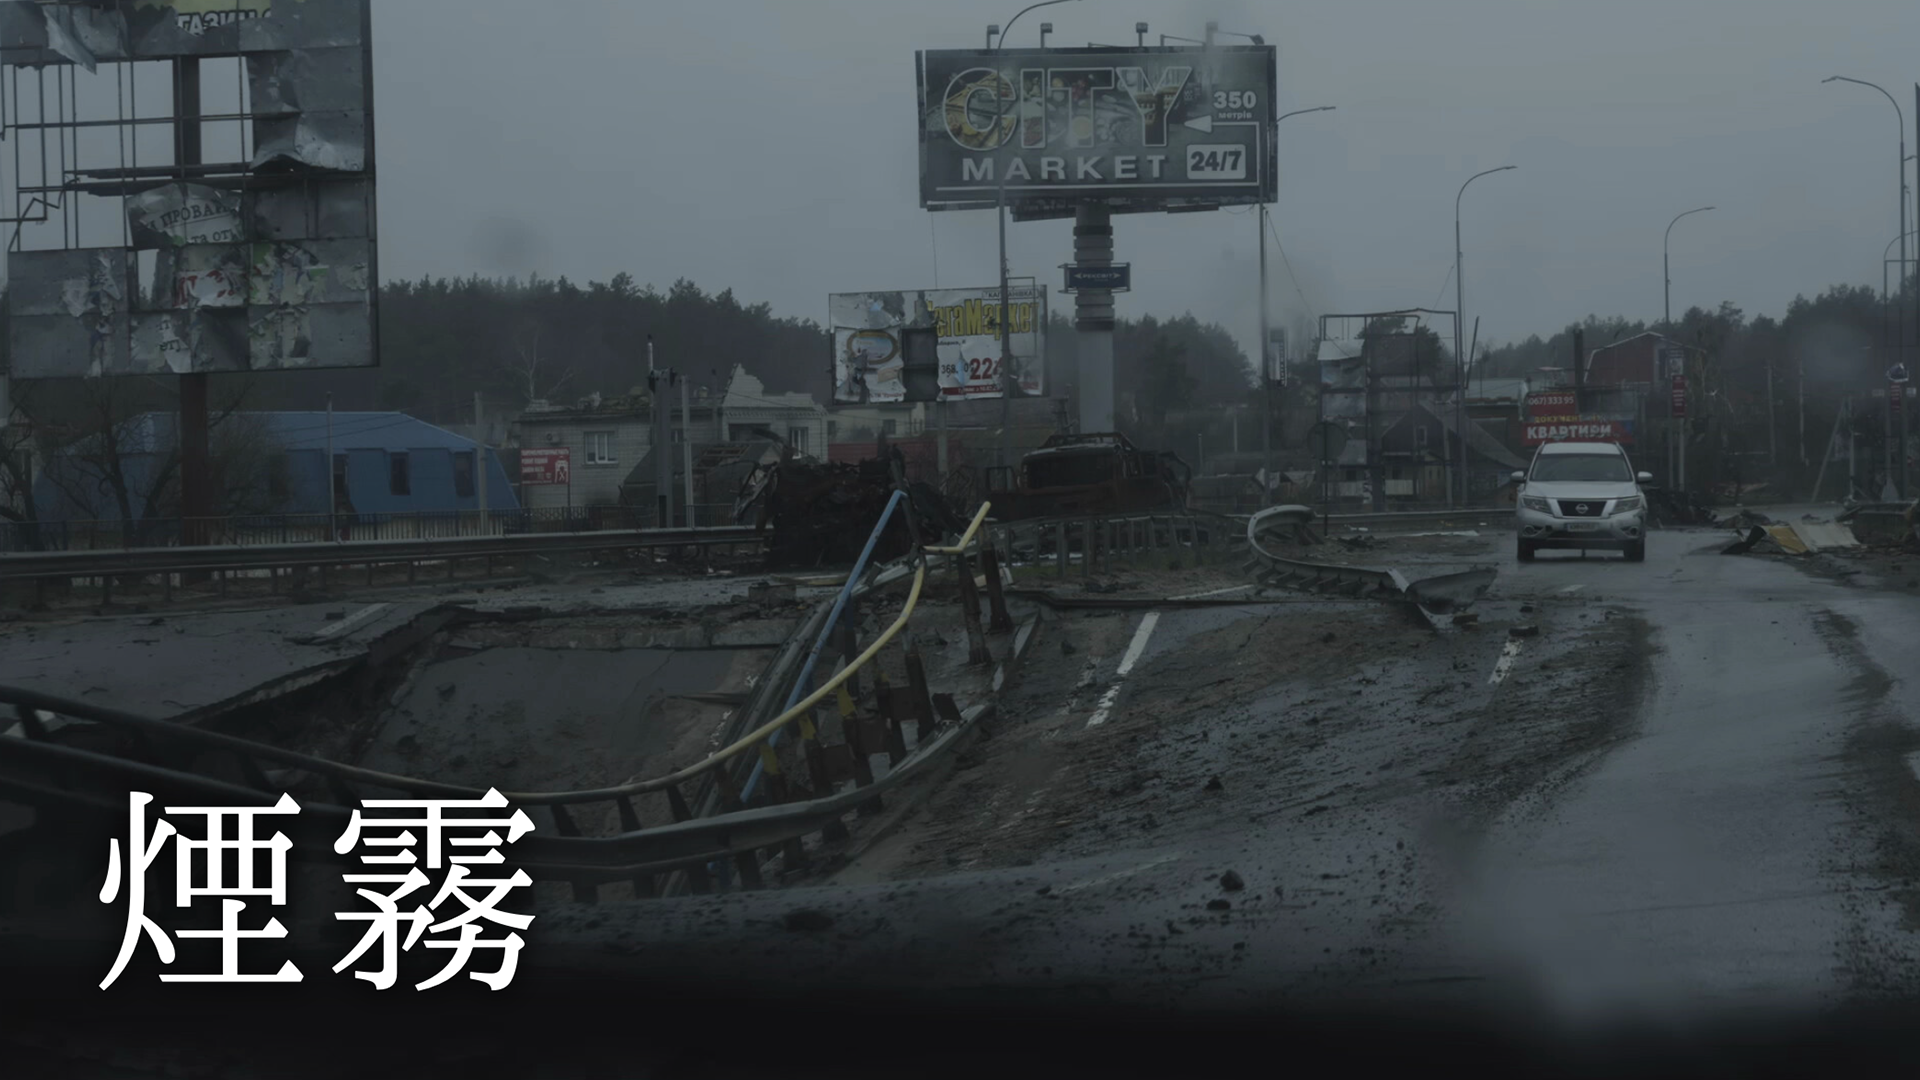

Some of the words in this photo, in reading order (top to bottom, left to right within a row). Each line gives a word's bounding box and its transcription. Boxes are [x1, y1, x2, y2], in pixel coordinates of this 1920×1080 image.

[942, 66, 1192, 150] CITY
[1213, 91, 1257, 109] 350
[1218, 110, 1252, 120] метрів
[962, 155, 1166, 181] MARKET
[1190, 150, 1243, 171] 24/7
[1548, 396, 1563, 405] 333
[1527, 424, 1612, 439] КВАРТИРИ
